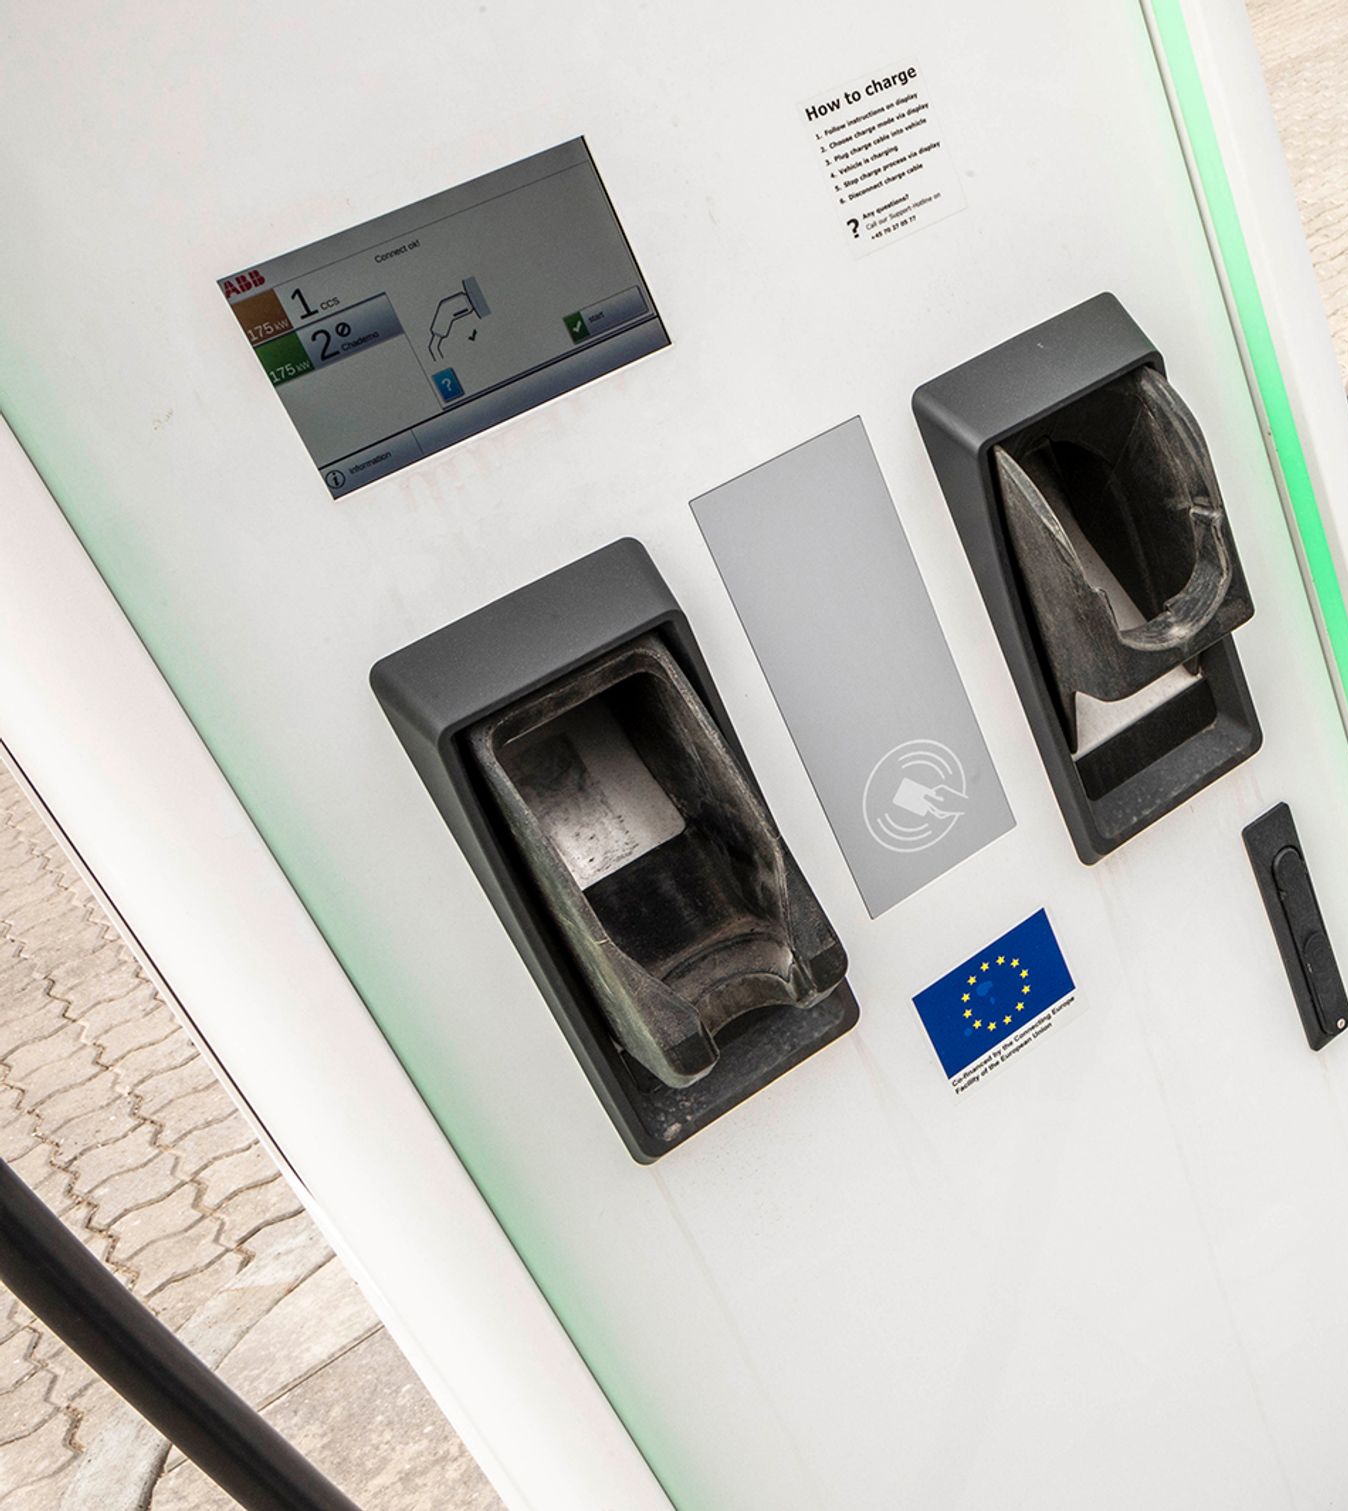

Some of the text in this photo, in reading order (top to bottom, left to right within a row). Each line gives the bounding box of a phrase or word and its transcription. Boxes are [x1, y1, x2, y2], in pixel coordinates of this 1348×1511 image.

[805, 66, 917, 121] How to charge
[824, 123, 845, 136] Follow
[847, 107, 885, 126] instructions
[895, 93, 918, 106] display
[829, 136, 852, 149] Choose
[854, 125, 876, 139] charge
[877, 117, 894, 128] mode
[896, 110, 906, 121] via
[907, 102, 929, 116] display
[834, 150, 849, 162] Plug
[850, 141, 872, 155] charge
[873, 134, 890, 146] cable
[891, 128, 904, 137] into
[905, 118, 927, 131] vehicle
[838, 160, 862, 175] Vehicle
[863, 155, 869, 164] is
[870, 145, 898, 161] charging
[843, 177, 859, 188] Stop
[860, 167, 881, 182] charge
[882, 156, 907, 171] process
[908, 151, 918, 159] via
[918, 141, 941, 155] display
[848, 181, 883, 200] Disconnect
[884, 171, 906, 185] charge
[907, 163, 923, 175] cable
[862, 193, 909, 220] Any questions?
[866, 219, 878, 231] Call
[374, 245, 408, 263] Connect
[223, 269, 265, 299] ABB
[291, 288, 340, 319] 1 CCS
[247, 319, 289, 342] 175 kW
[311, 329, 340, 362] 2
[269, 365, 296, 383] 175
[952, 996, 1075, 1087] Co-financed by the Connecting Europe
[955, 1022, 1052, 1095] Facility of the European Union
